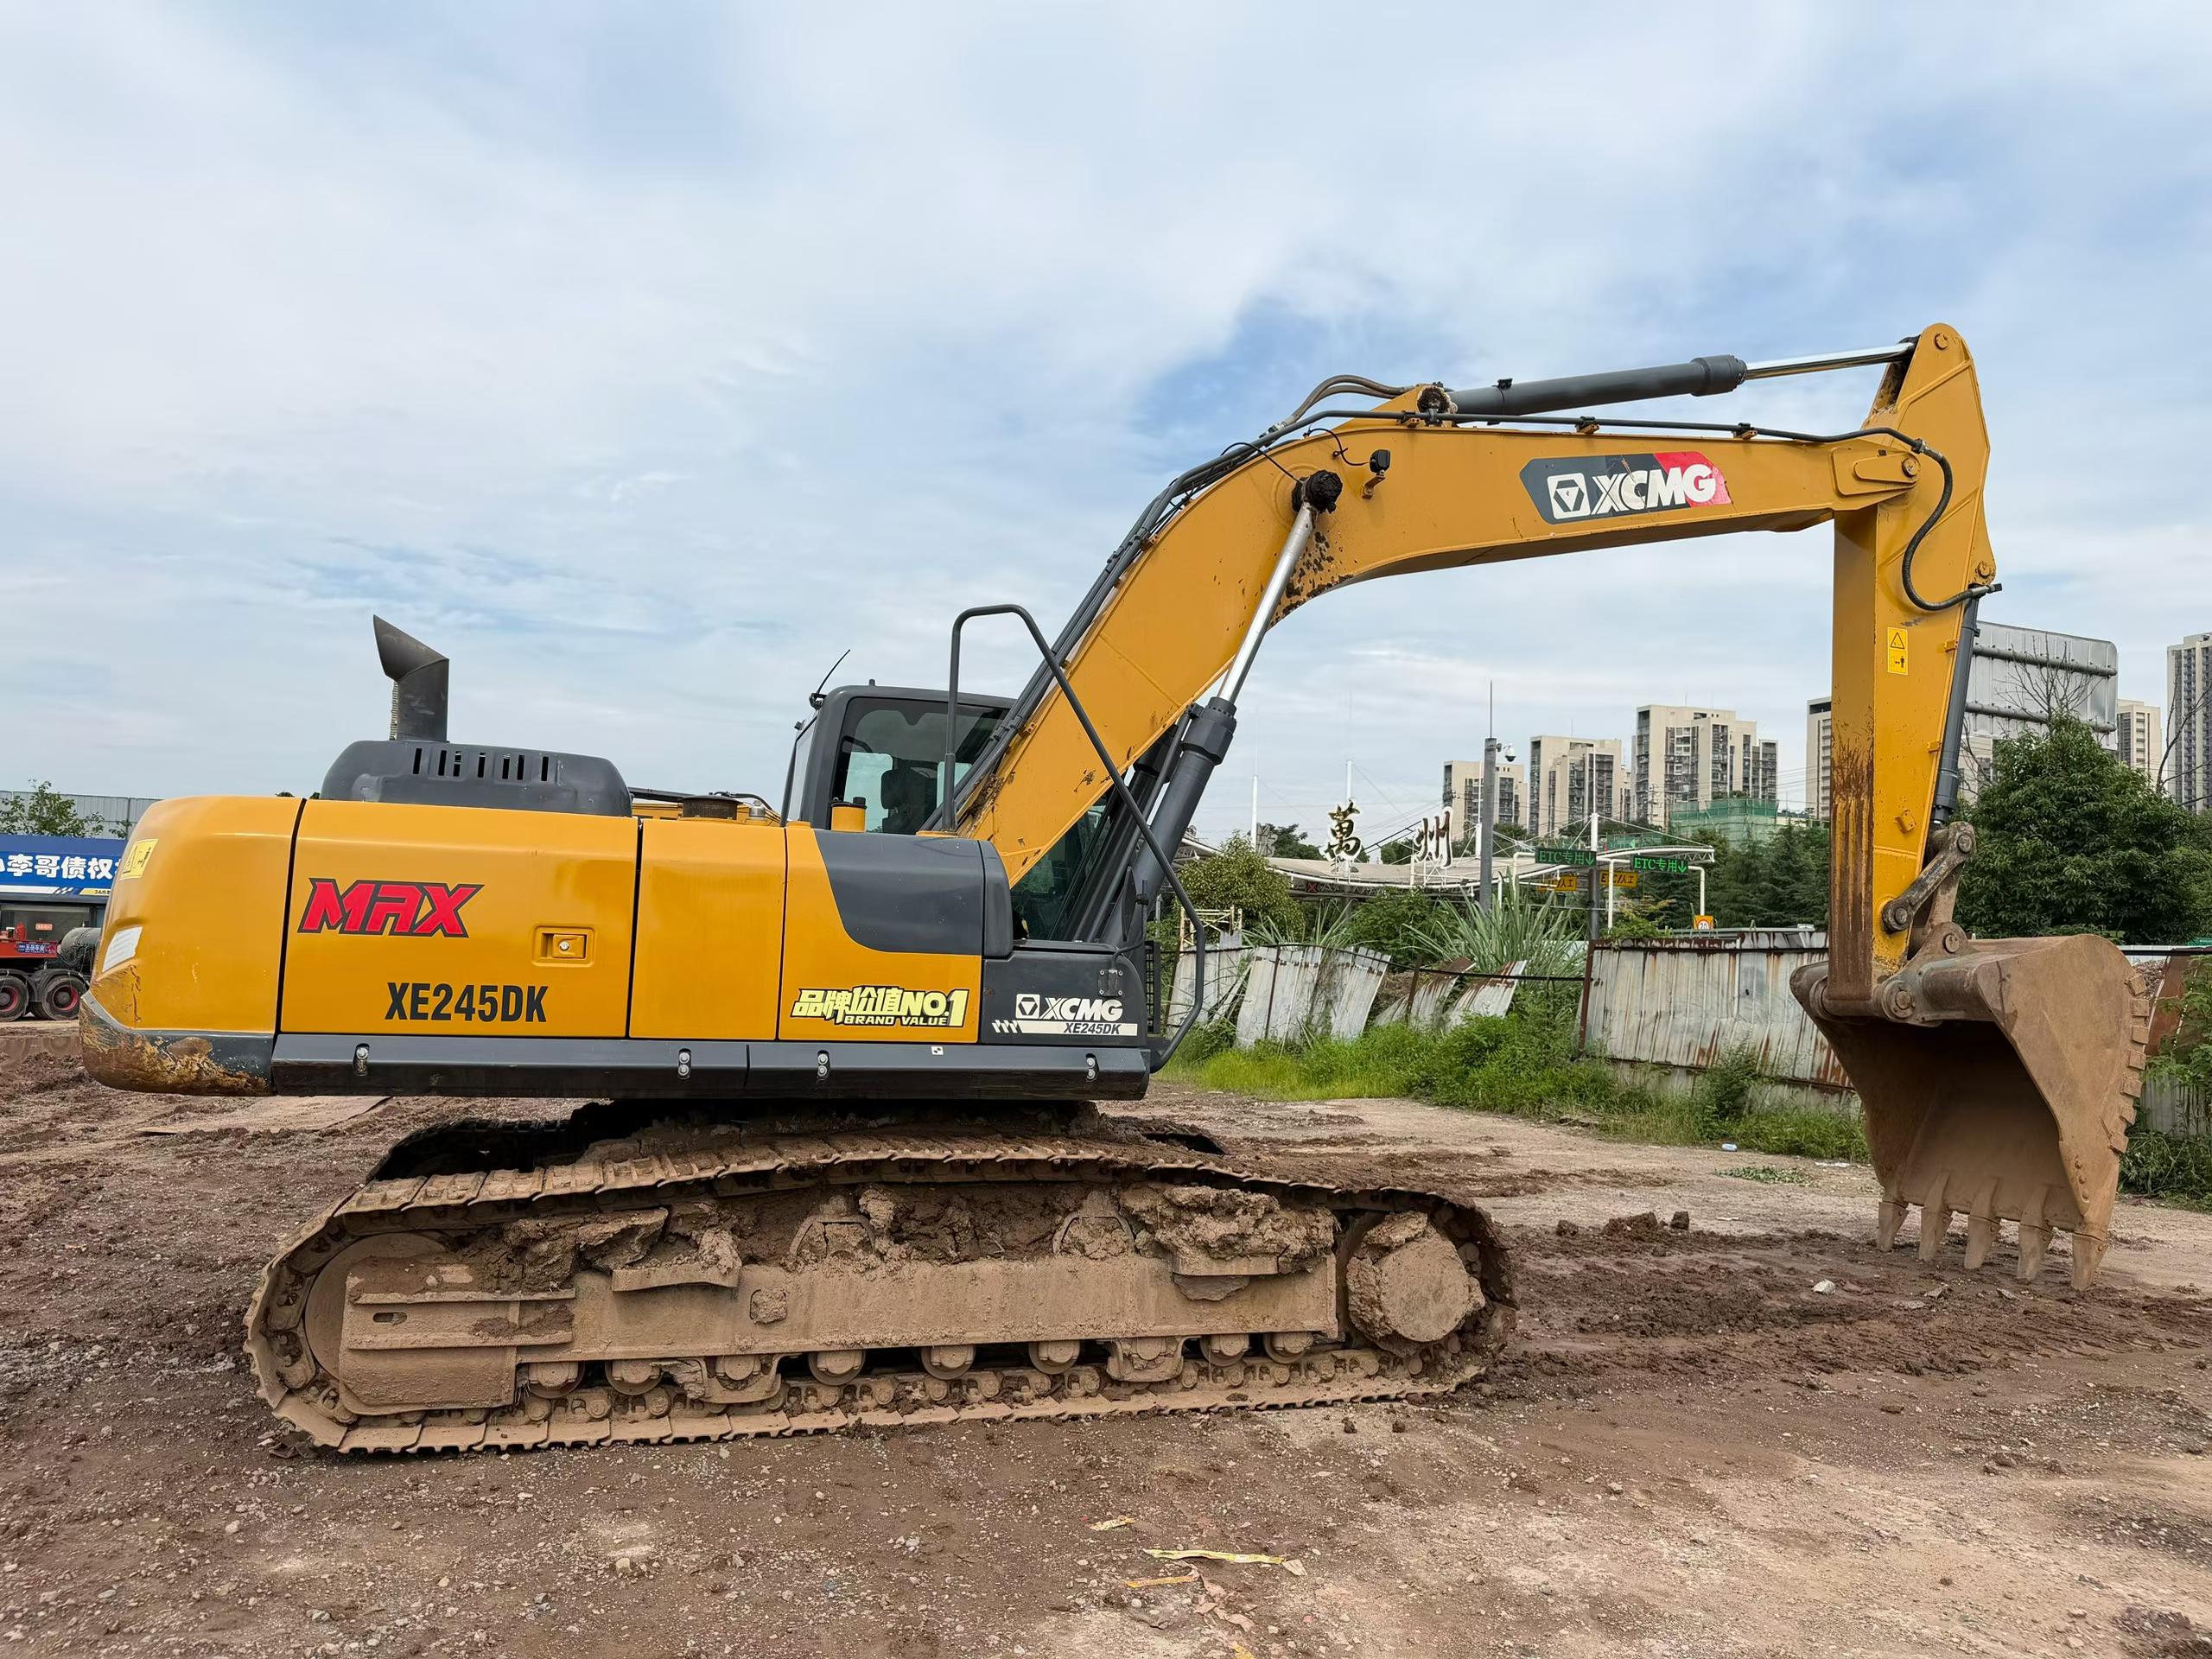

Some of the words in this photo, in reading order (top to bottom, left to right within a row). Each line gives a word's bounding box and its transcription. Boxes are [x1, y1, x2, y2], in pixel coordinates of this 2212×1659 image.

[1591, 464, 1716, 515] XCMG
[0, 854, 121, 880] 李哥债权
[1539, 850, 1585, 864] ETC专用
[1634, 857, 1677, 872] ETC专用
[1601, 873, 1635, 884] EC/人工
[297, 878, 485, 938] MAX
[385, 982, 549, 1023] XE245DK
[1039, 997, 1123, 1022] XCMG
[843, 1016, 894, 1026] BRAND
[902, 1017, 949, 1027] VALUE
[1063, 1022, 1122, 1035] XE245DK
